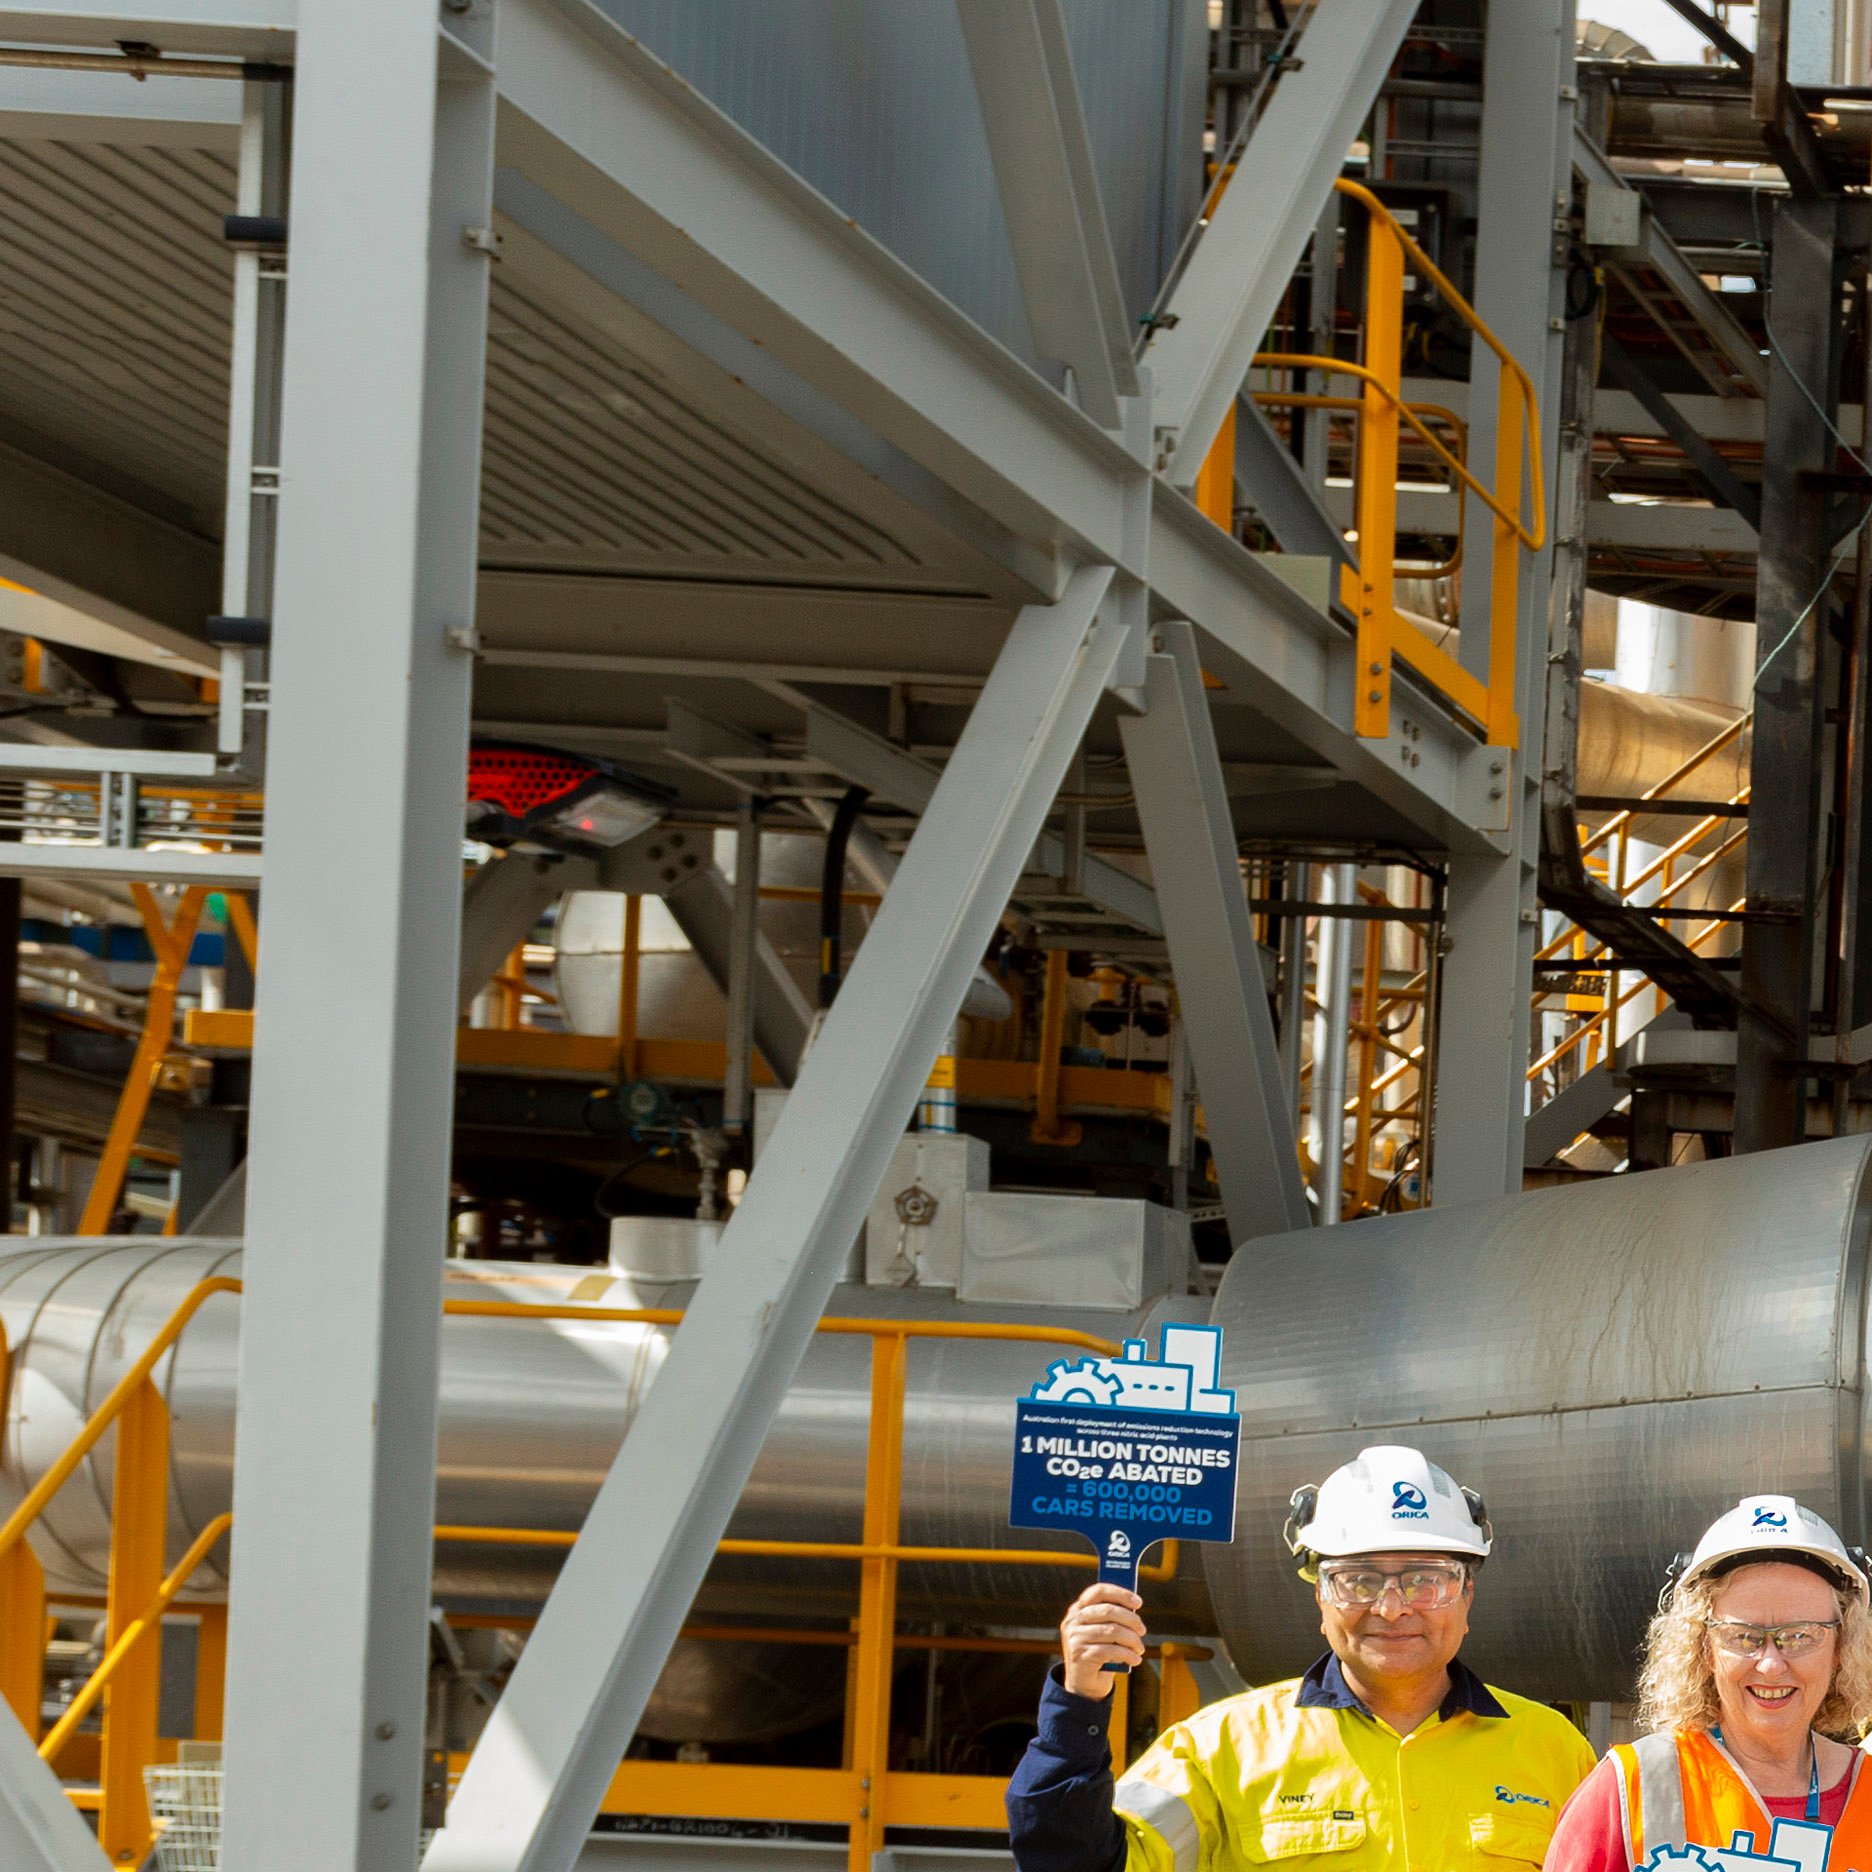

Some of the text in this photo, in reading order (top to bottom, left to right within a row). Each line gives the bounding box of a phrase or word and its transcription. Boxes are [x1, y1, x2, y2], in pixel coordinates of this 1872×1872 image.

[1021, 1435, 1231, 1468] 1 MILLION TONNES
[1107, 1462, 1203, 1486] ABATED
[1082, 1479, 1182, 1504] 600,000
[1031, 1495, 1213, 1526] CARS REMOVED
[1391, 1511, 1430, 1520] ORICA
[1278, 1793, 1315, 1804] VINEY
